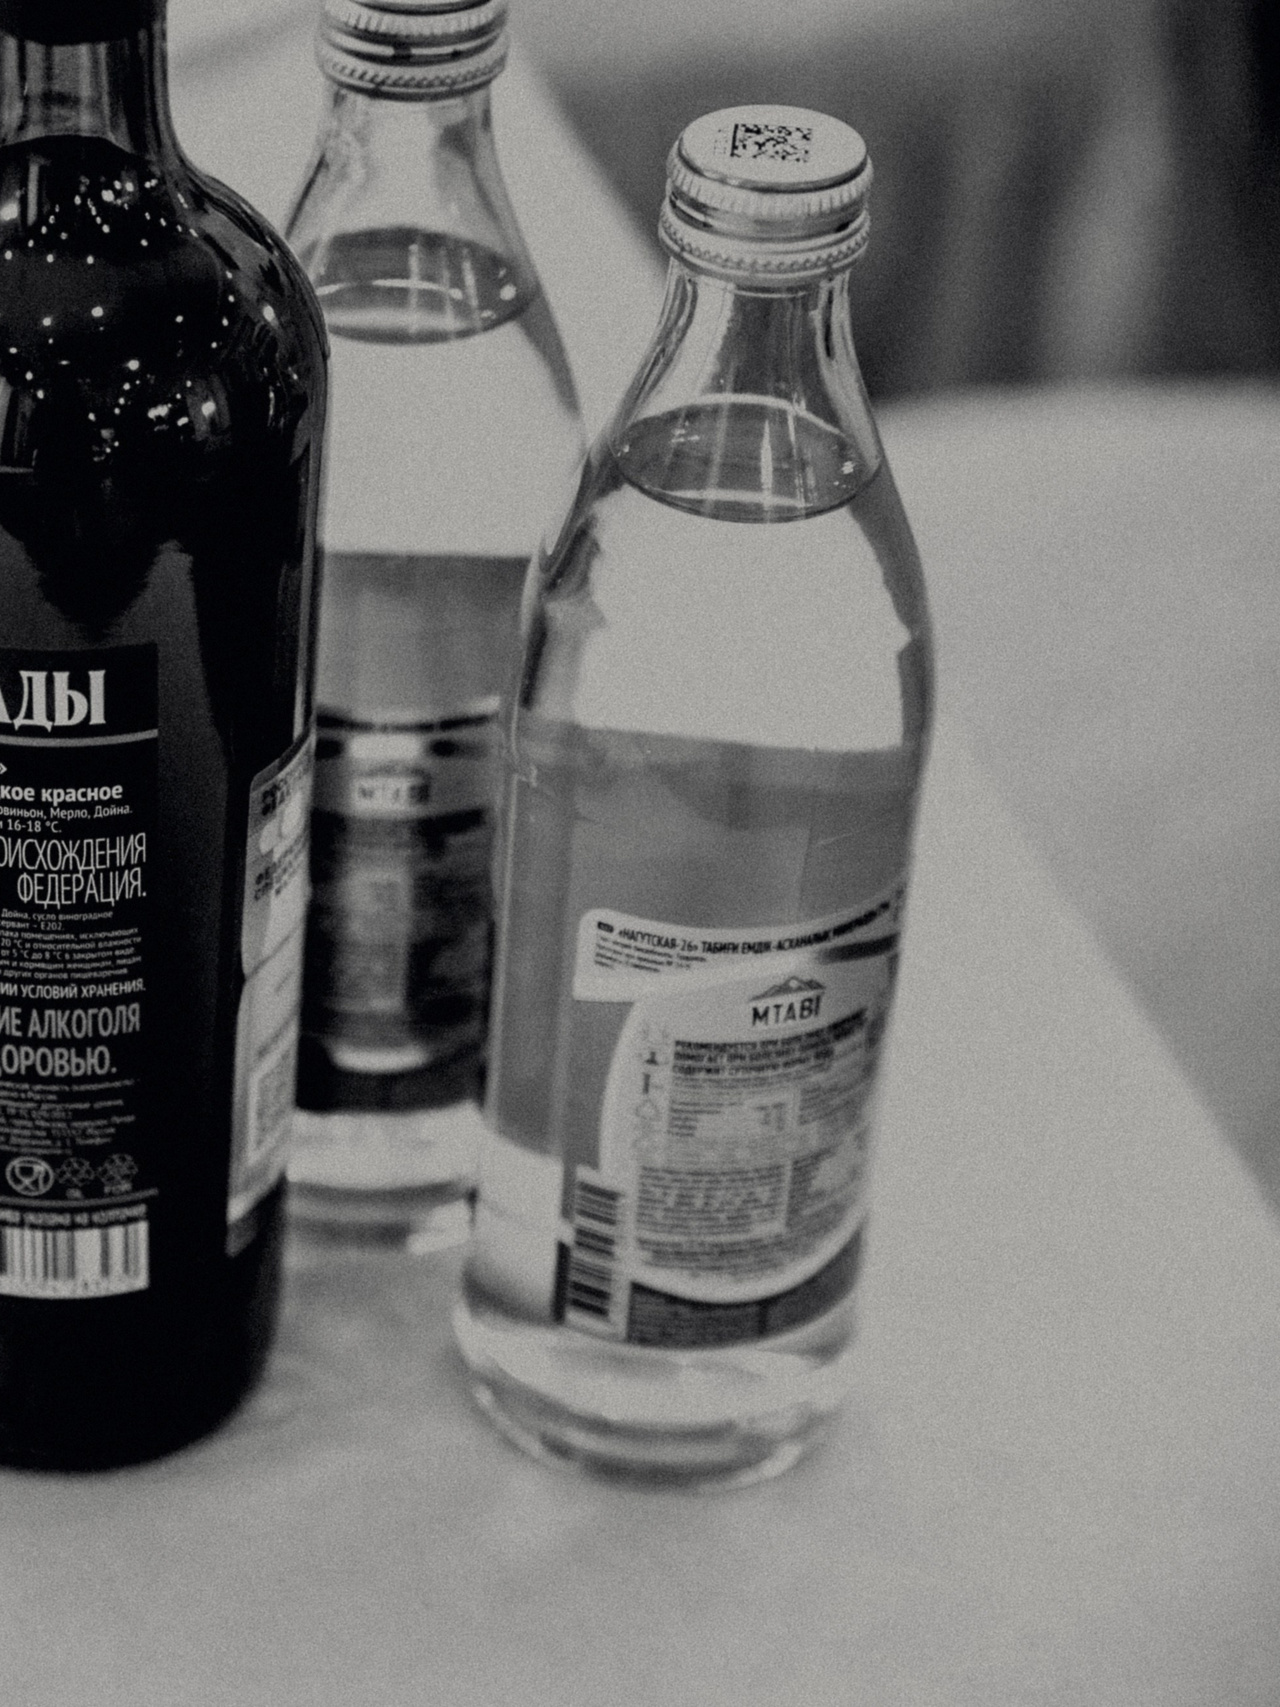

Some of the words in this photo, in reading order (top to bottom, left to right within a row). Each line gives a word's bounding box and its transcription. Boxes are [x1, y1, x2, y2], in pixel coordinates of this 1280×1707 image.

[41, 784, 123, 806] красное
[50, 807, 91, 820] Мерло,
[93, 804, 133, 818] Дойна.
[7, 818, 42, 832] 16-18
[17, 866, 147, 909] ФЕДЕРАЦИЯ.
[21, 983, 78, 999] УСЛОВИЙ
[81, 978, 147, 998] ХРАНЕНИЯ.
[27, 1002, 141, 1040] АЛКОГОЛЯ
[751, 995, 823, 1026] MTABI
